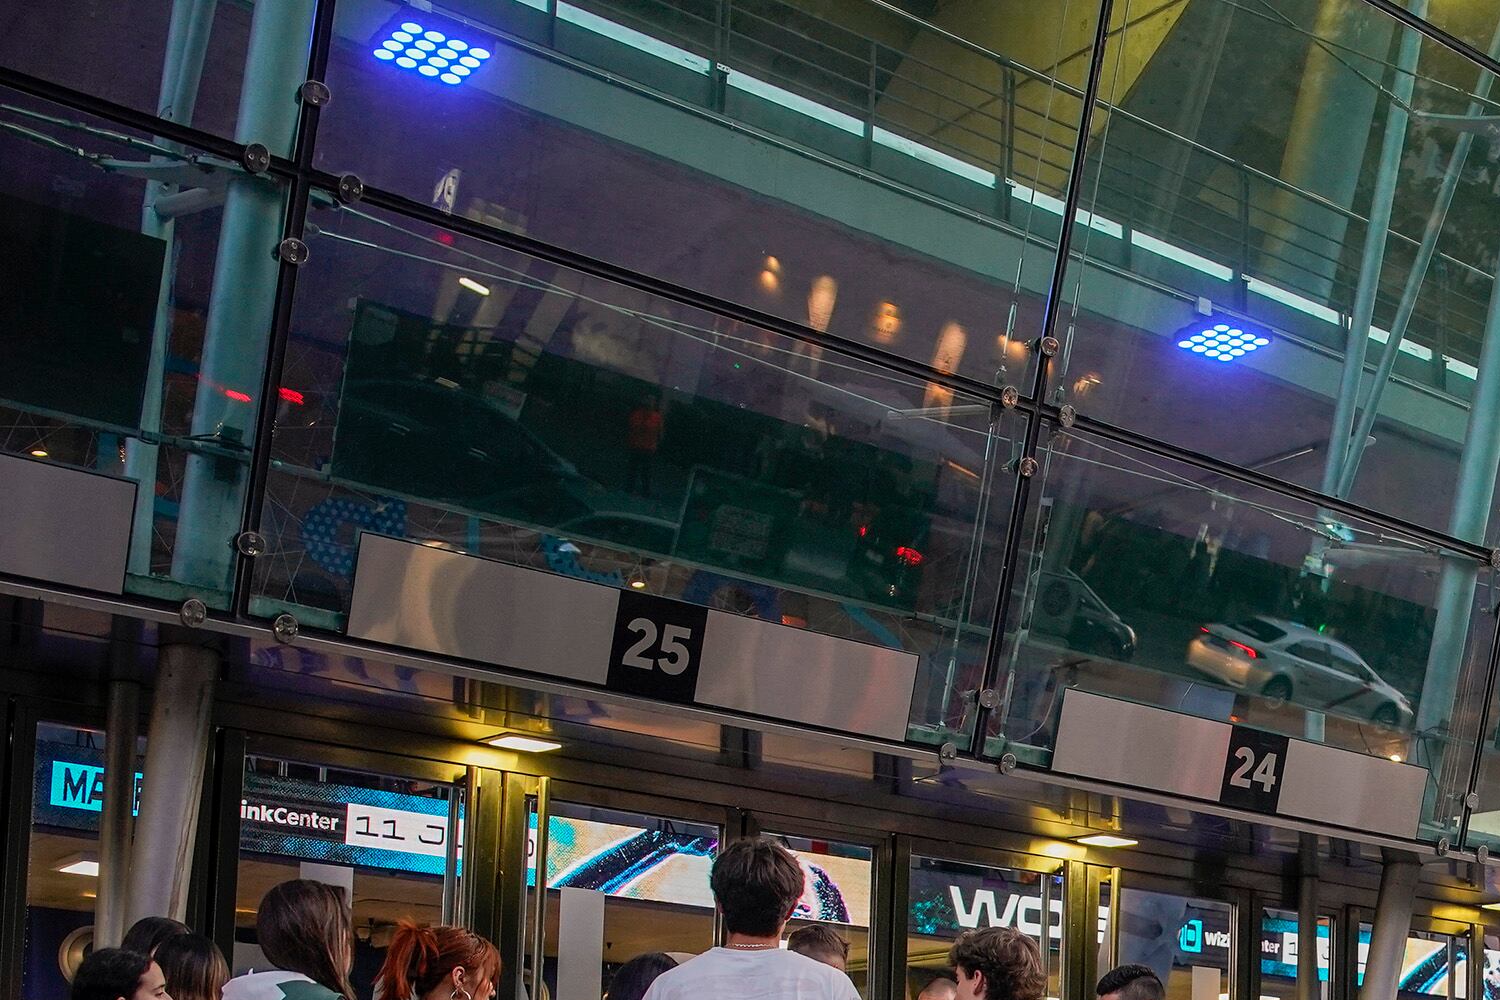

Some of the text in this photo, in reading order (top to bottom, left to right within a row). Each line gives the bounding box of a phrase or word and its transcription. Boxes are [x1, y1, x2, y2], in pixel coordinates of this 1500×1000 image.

[622, 617, 692, 676] 25
[1230, 746, 1277, 793] 24
[355, 815, 406, 841] 11
